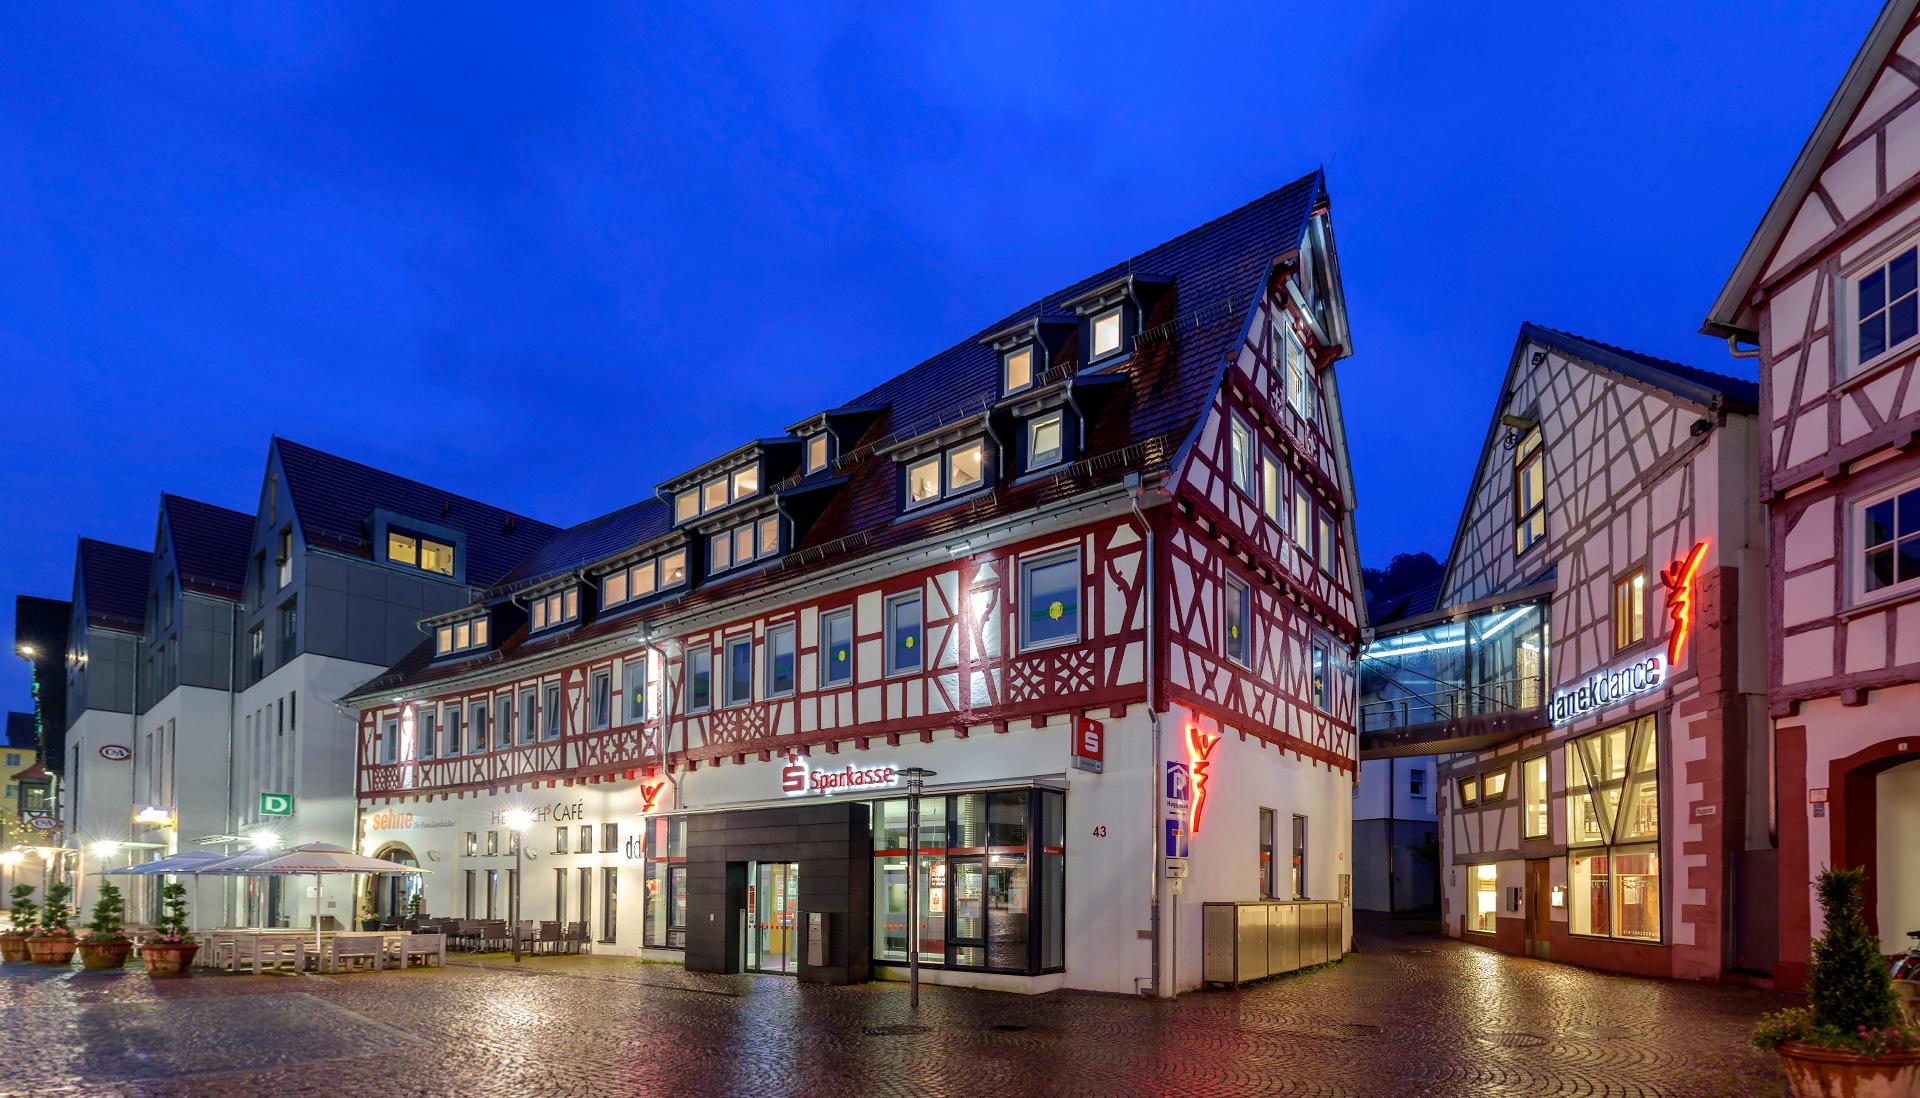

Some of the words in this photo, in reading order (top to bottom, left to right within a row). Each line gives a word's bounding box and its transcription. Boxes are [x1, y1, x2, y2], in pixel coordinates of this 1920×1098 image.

[1547, 657, 1660, 724] danekdance
[810, 765, 895, 794] Sparkasse
[265, 796, 288, 812] D
[553, 798, 584, 822] CAFÉ
[372, 808, 413, 831] sehne
[1092, 825, 1107, 838] 43
